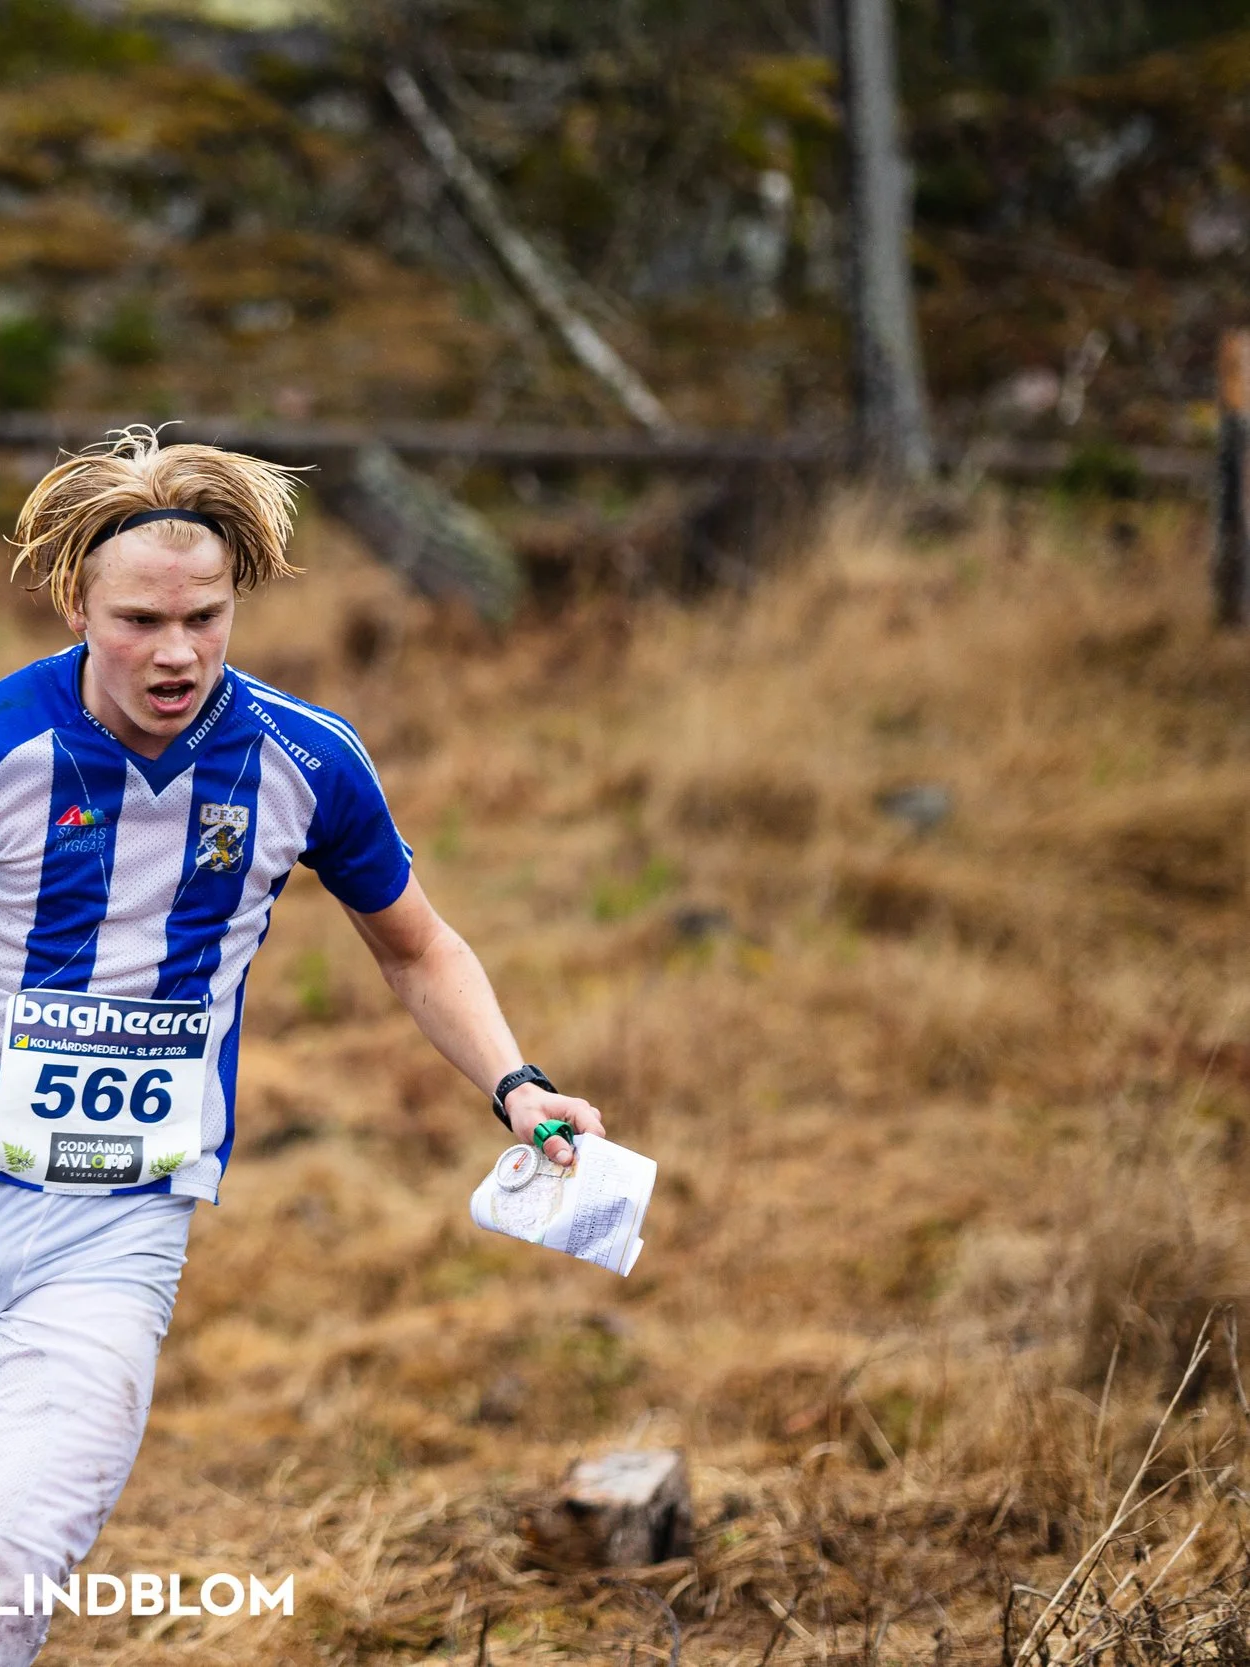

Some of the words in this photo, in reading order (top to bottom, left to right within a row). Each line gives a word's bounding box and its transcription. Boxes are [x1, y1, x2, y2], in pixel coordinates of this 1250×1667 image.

[186, 681, 233, 750] noname
[13, 994, 210, 1037] bagheera
[29, 1037, 128, 1056] KOLMÅRDSMEDELN
[136, 1047, 148, 1057] SL
[149, 1047, 163, 1056] #2
[164, 1046, 187, 1056] 2026
[30, 1063, 173, 1123] 566
[55, 1153, 133, 1170] AVLOPP
[57, 1139, 135, 1155] GODKÄNDA
